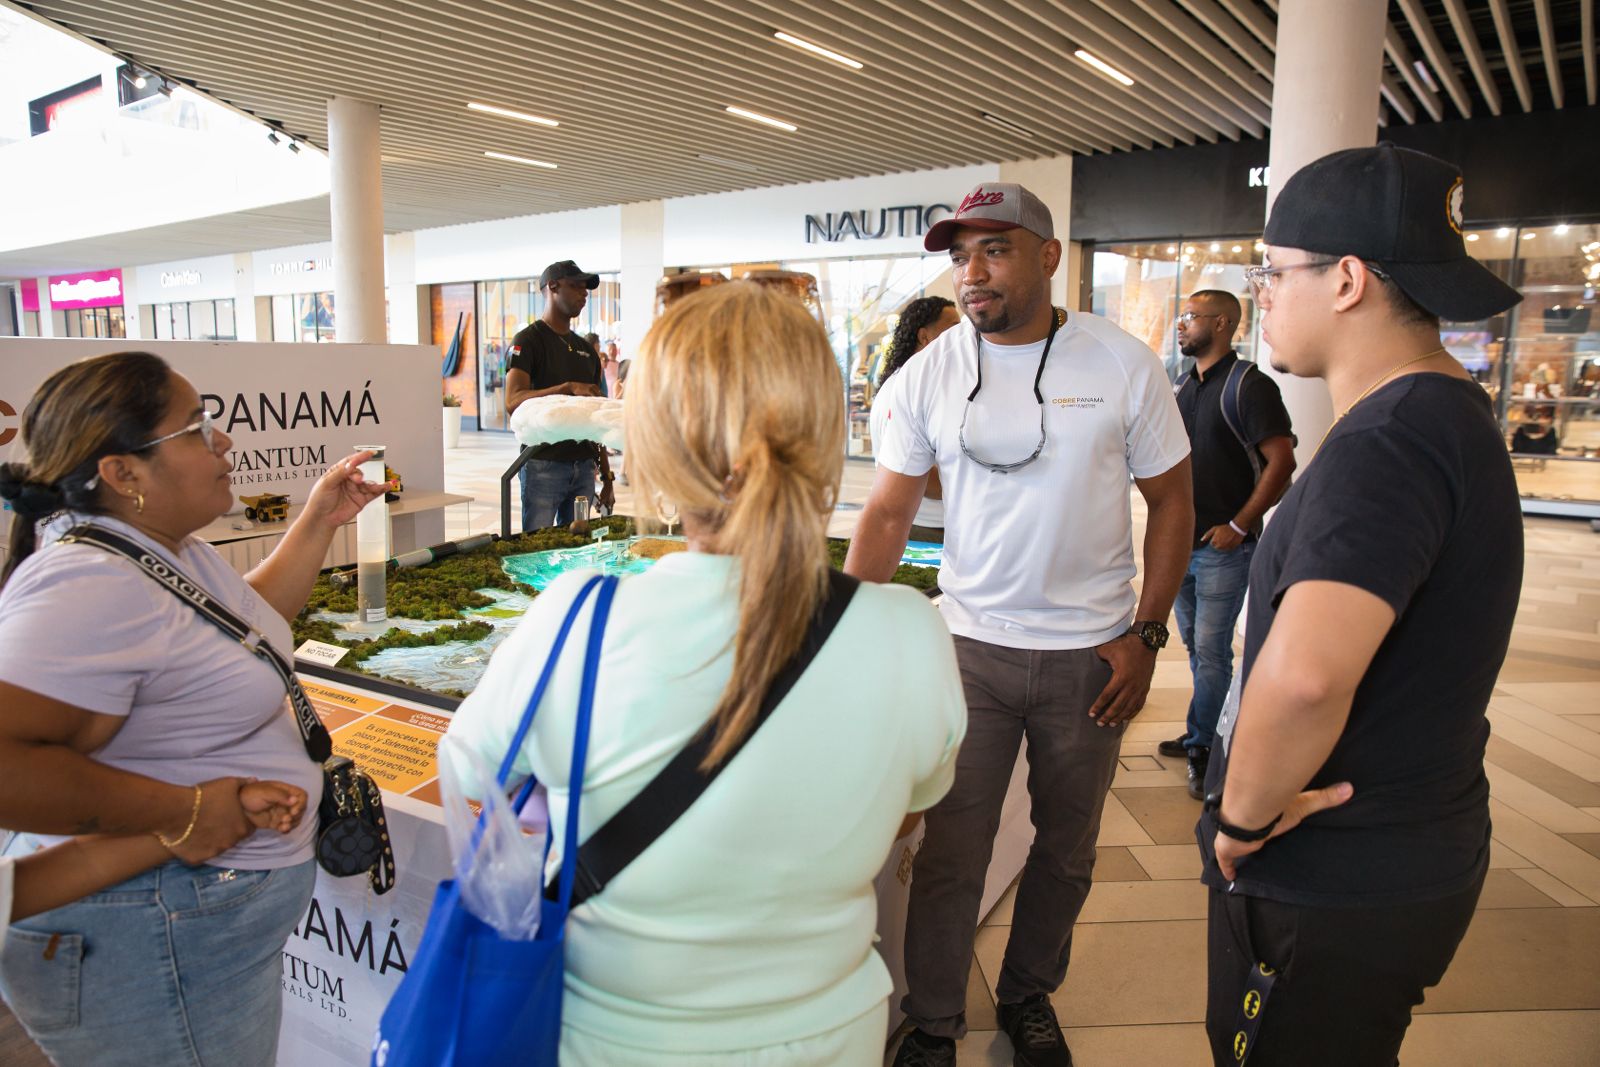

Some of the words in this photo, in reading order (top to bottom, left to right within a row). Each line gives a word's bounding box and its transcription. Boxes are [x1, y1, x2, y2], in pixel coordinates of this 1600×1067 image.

[805, 203, 953, 243] NAUTIC
[270, 259, 304, 275] TOMMY
[200, 379, 380, 434] PANAMÁ
[230, 444, 327, 473] UANTUM
[140, 554, 208, 605] COACH
[353, 731, 376, 741] plazo
[384, 730, 418, 743] proceso
[345, 739, 371, 750] donde
[370, 746, 420, 764] restauramos
[419, 759, 430, 768] la
[354, 752, 371, 760] del
[366, 756, 406, 772] proyecto
[367, 767, 398, 781] nativas
[294, 898, 408, 975] AMÁ
[282, 979, 313, 1003] RALS
